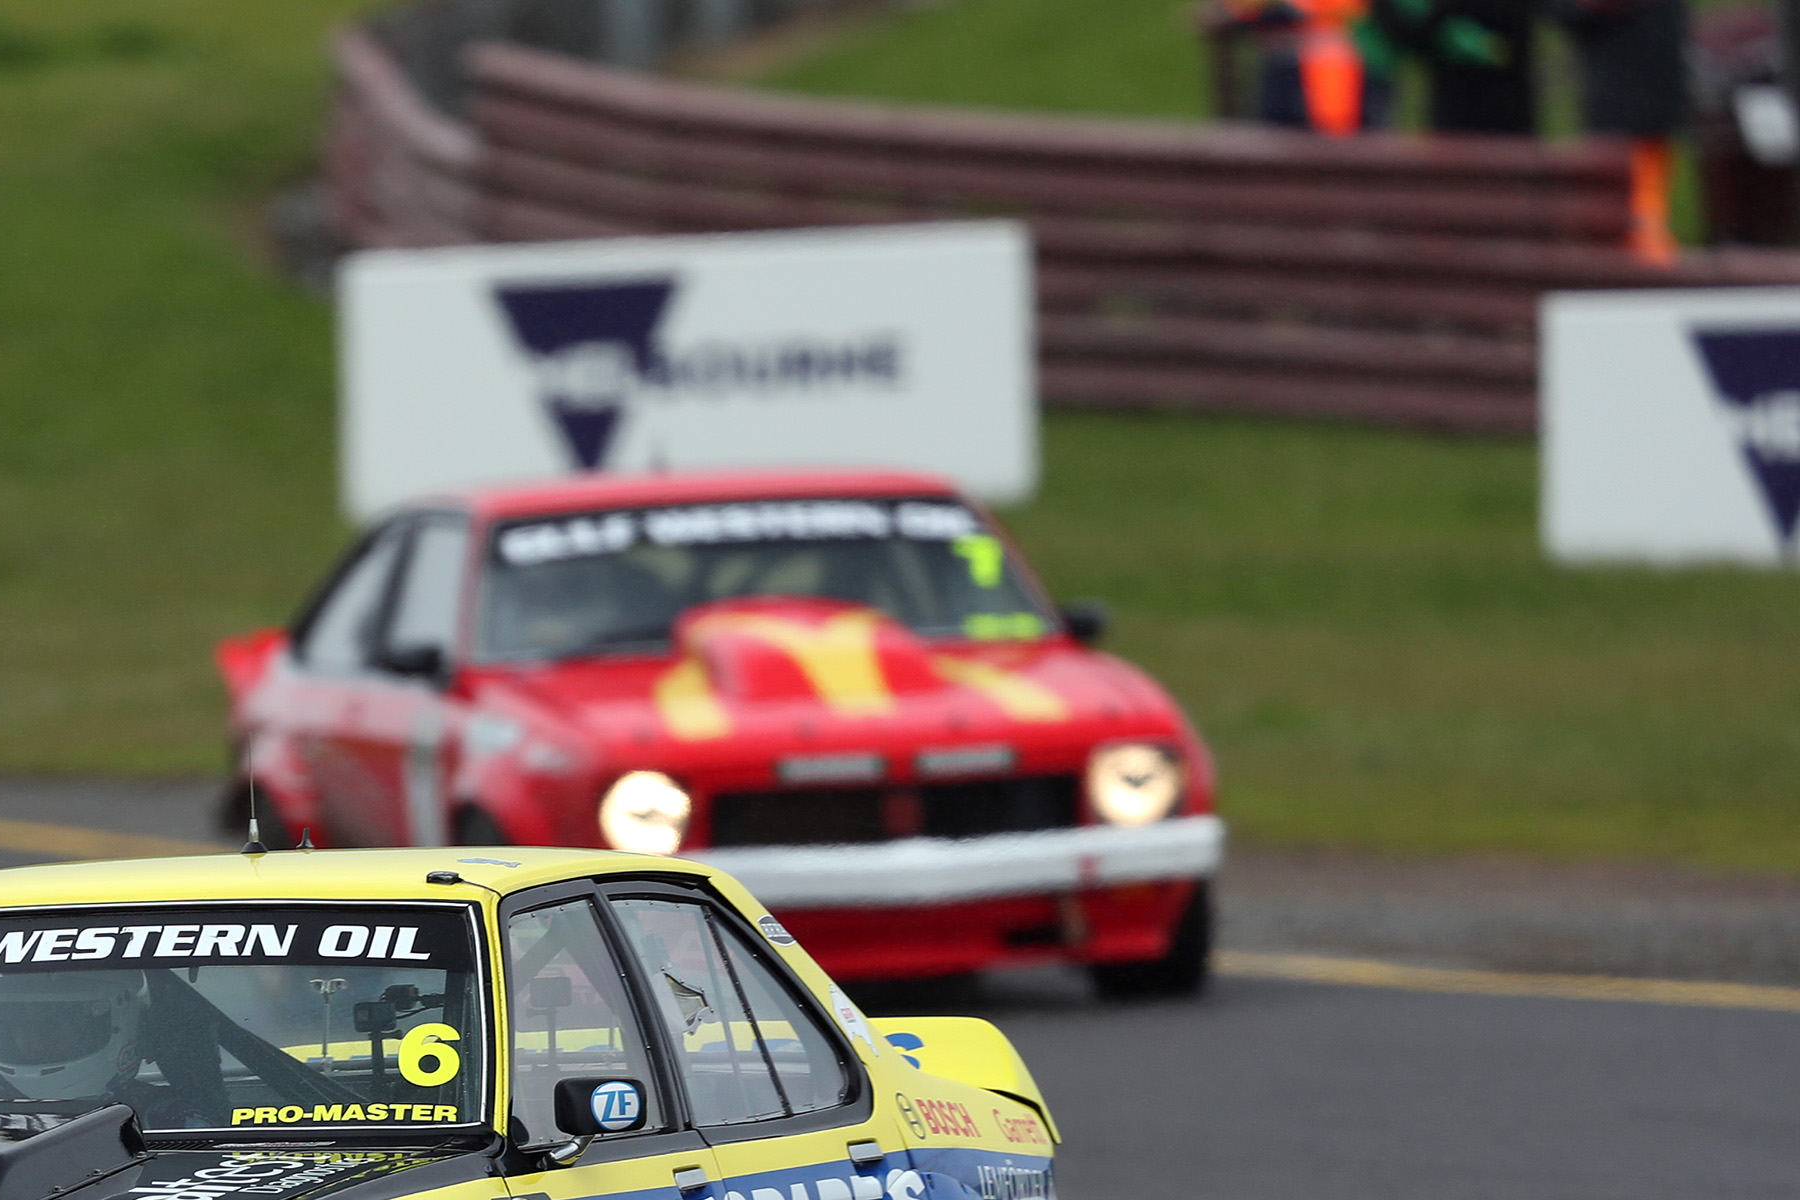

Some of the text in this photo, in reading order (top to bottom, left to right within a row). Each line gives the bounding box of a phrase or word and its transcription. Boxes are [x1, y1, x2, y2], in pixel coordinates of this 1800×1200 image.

[318, 925, 431, 961] OIL
[398, 1022, 461, 1087] 6
[231, 1103, 458, 1125] PRO-MASTER
[592, 1086, 639, 1123] ZF
[914, 1098, 981, 1138] BOSCH
